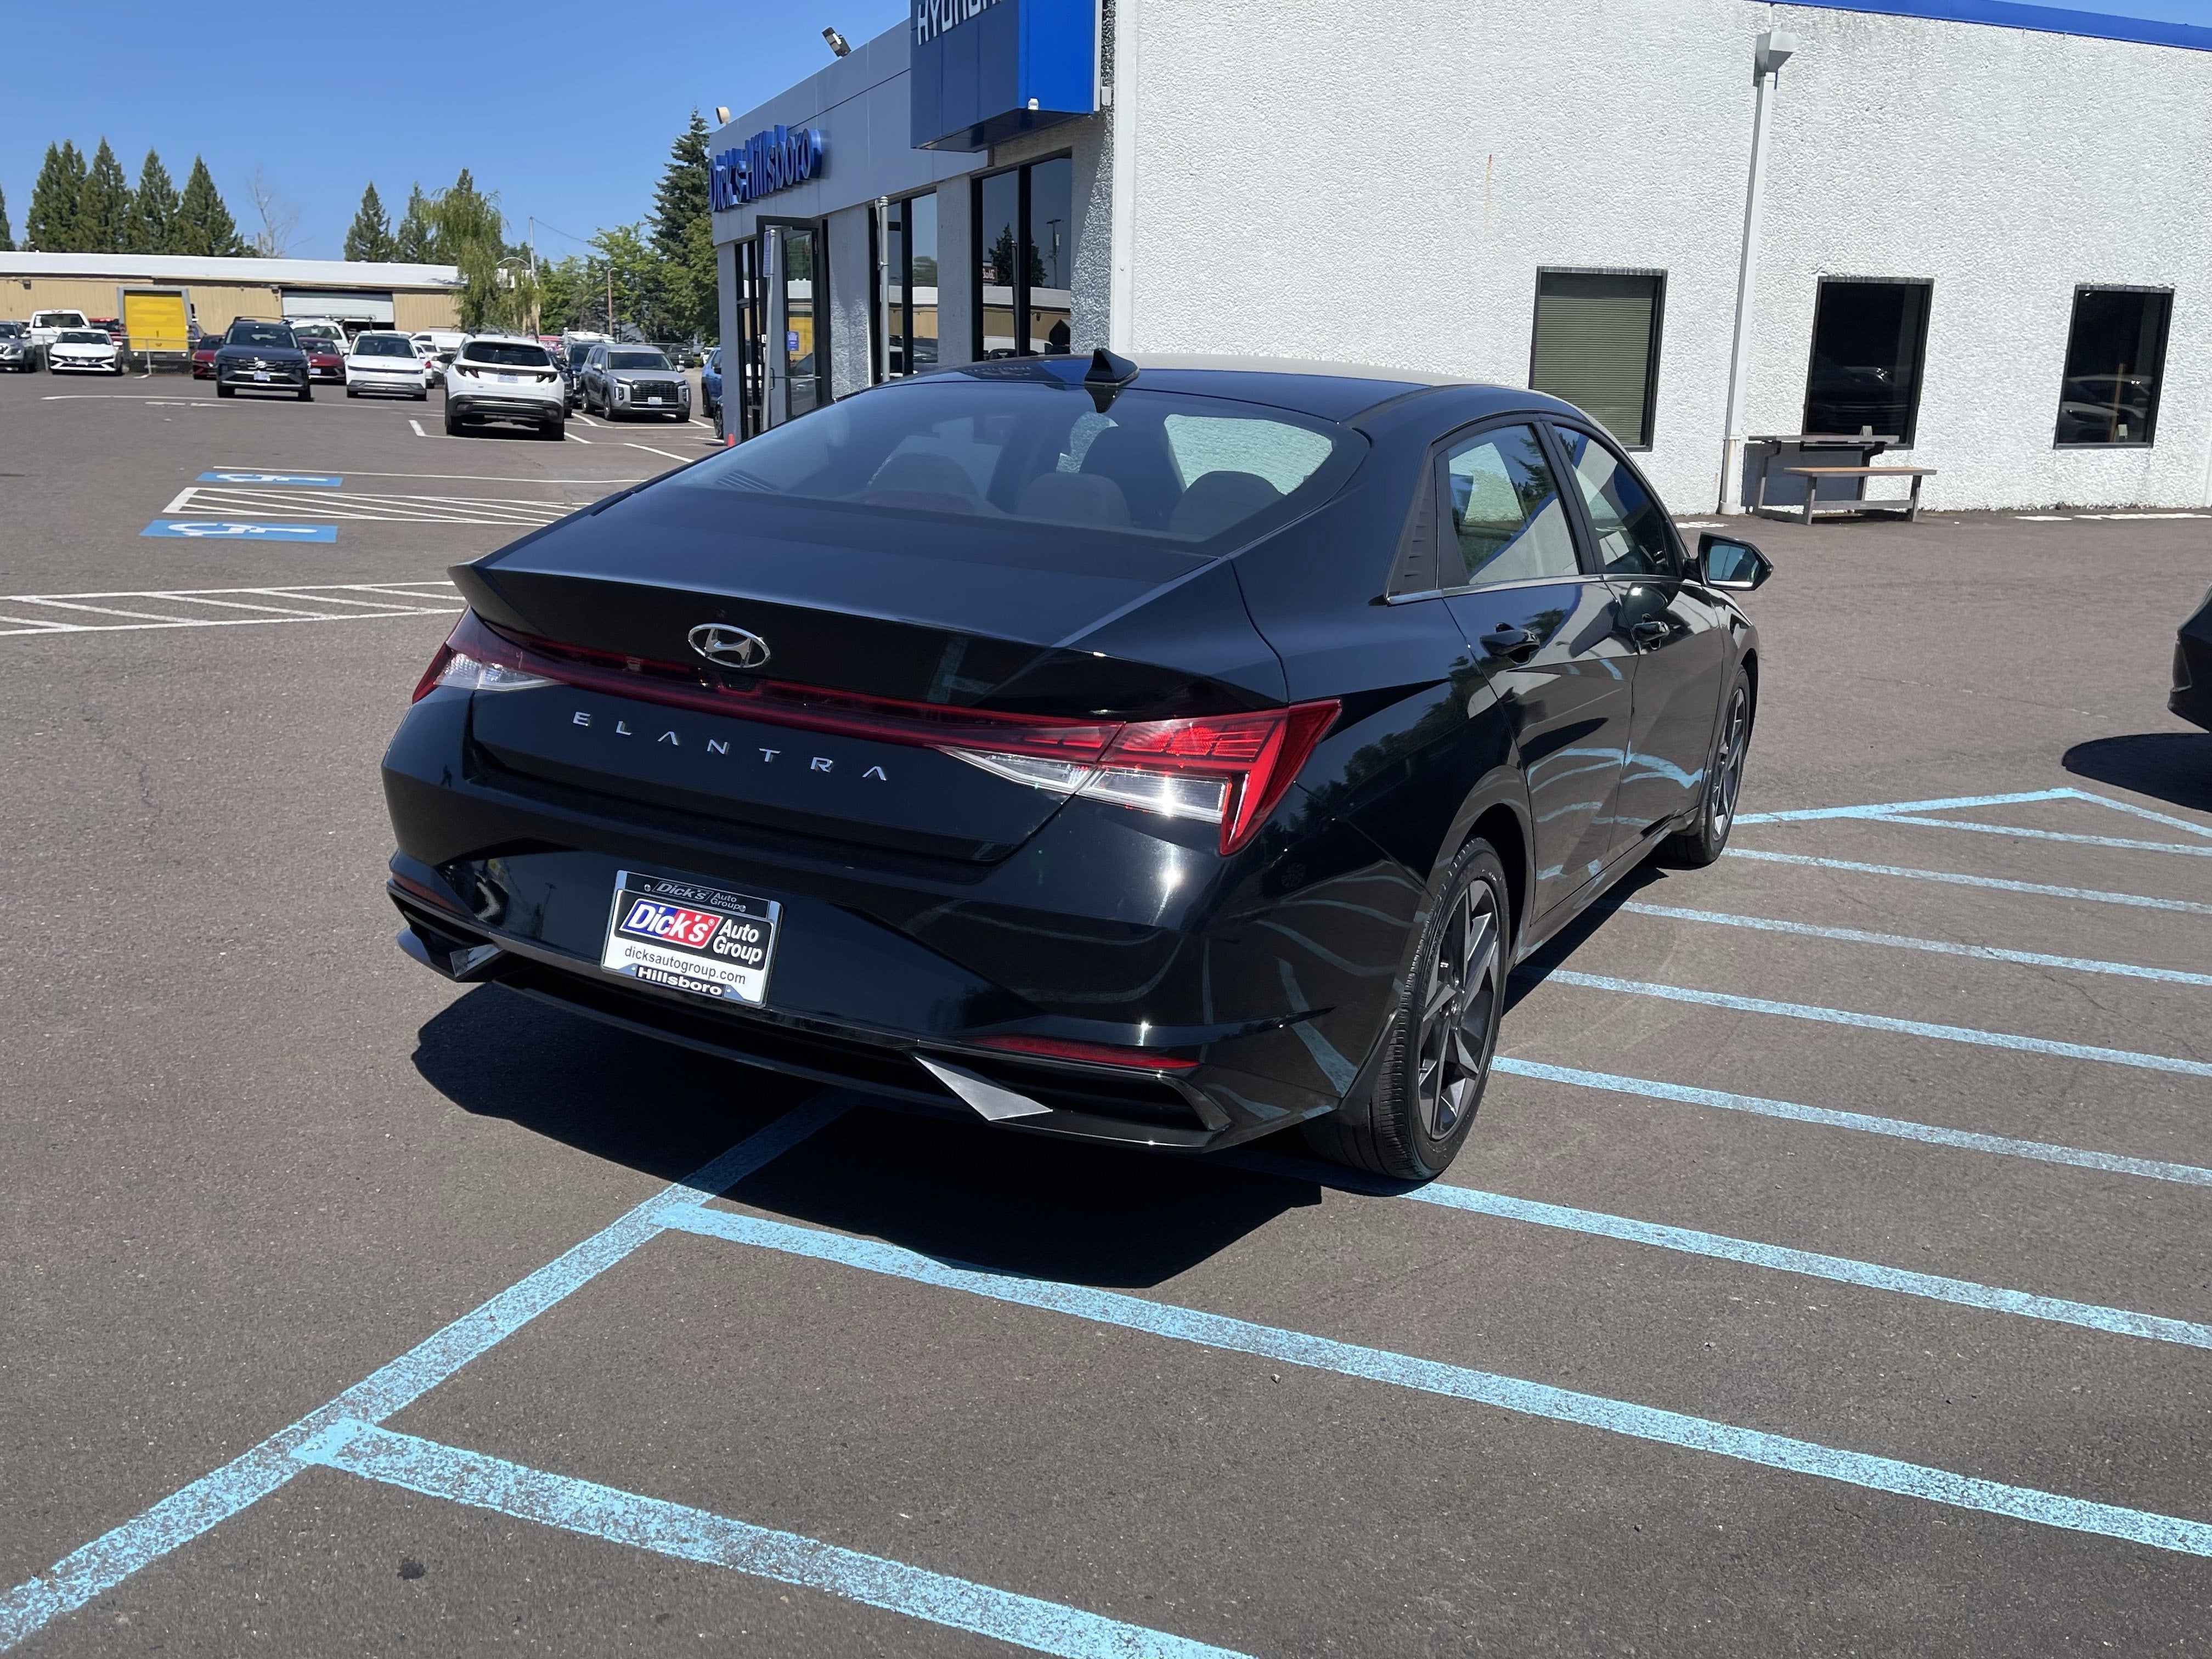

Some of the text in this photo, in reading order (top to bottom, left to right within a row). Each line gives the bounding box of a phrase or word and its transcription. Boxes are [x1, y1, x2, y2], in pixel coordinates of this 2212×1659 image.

[573, 712, 887, 781] ELANTRA
[657, 883, 737, 902] Dick's Auto
[710, 898, 740, 910] Group
[627, 904, 759, 943] Dick's Auto
[713, 935, 763, 964] Group
[625, 946, 746, 985] dicksautogroup.com
[637, 966, 723, 996] Hillsboro
